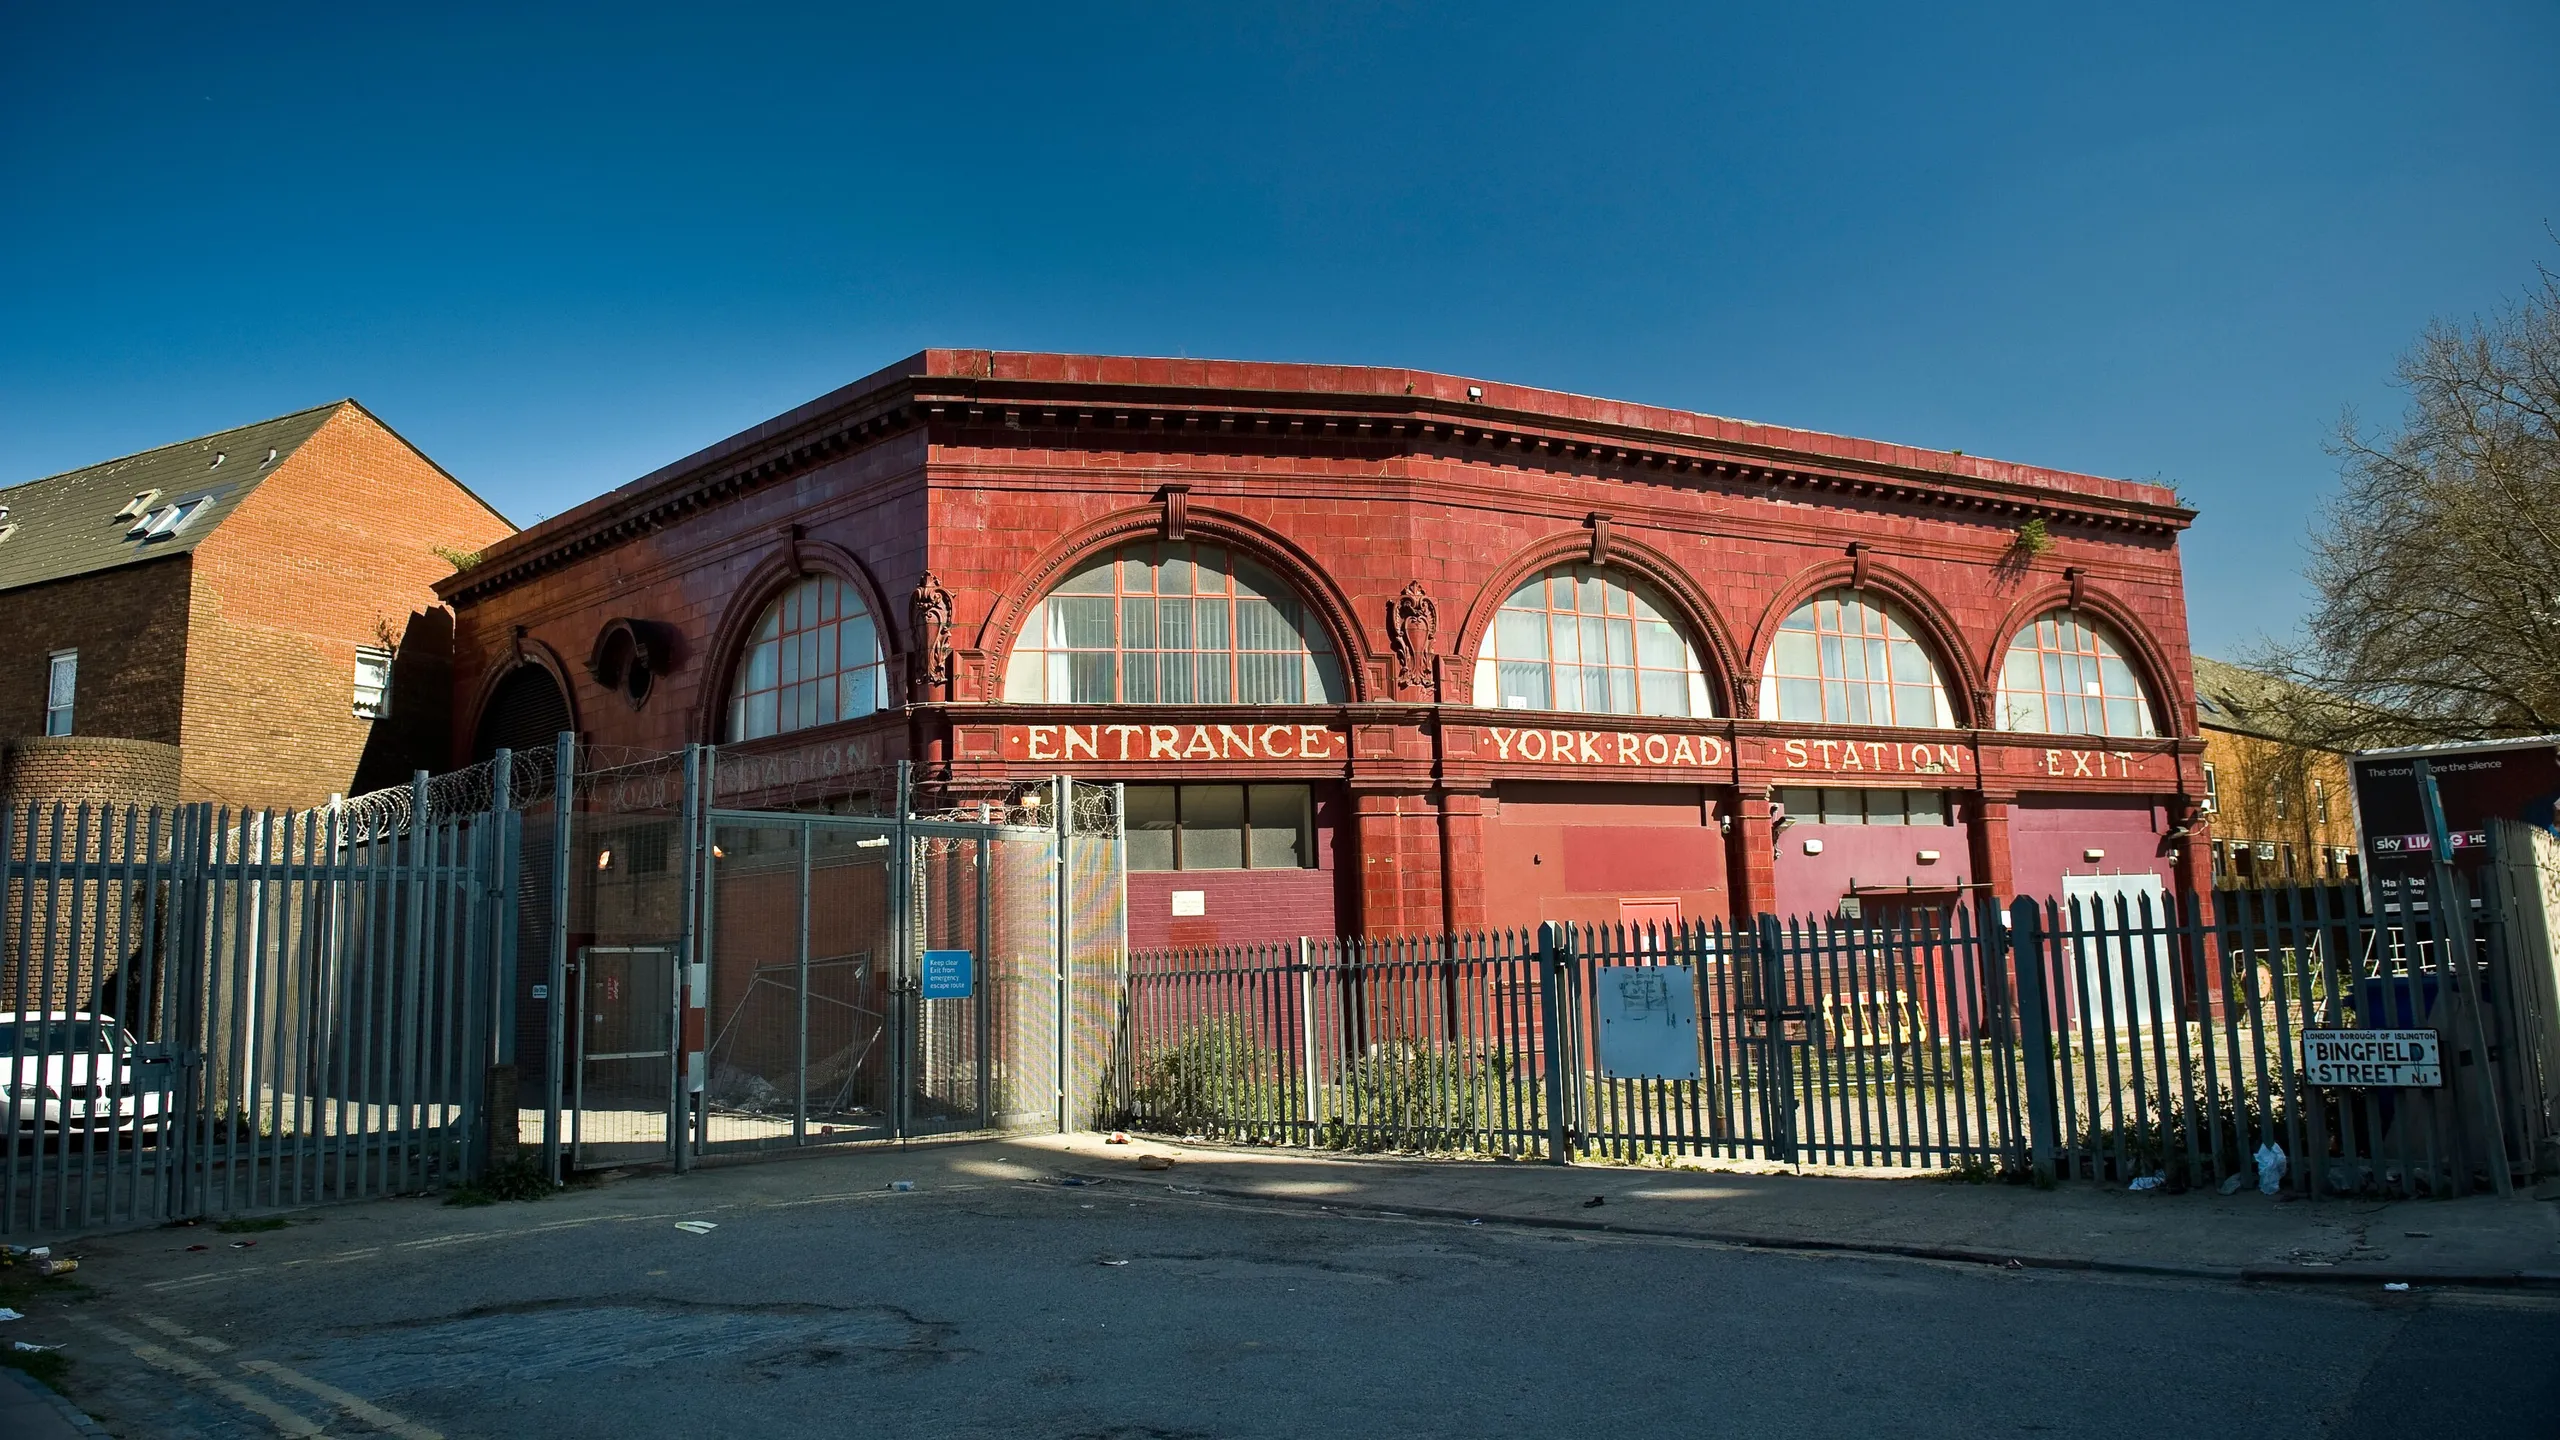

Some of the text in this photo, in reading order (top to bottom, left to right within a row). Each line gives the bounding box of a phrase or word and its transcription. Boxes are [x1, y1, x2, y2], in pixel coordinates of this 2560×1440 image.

[1027, 724, 1331, 761] ENTRANCE
[1489, 726, 1723, 766] YORK ROAD
[1785, 738, 1962, 773] STATION
[2045, 748, 2134, 778] EXIT
[2367, 768, 2386, 777] The
[2388, 767, 2414, 777] story
[2449, 763, 2467, 772] the
[2468, 760, 2502, 770] silence
[2376, 837, 2401, 851] sky
[2408, 834, 2464, 849] LIVG
[930, 959, 944, 967] Keep
[2305, 1032, 2436, 1040] LONDON BOROUGH OF ISLINGTON
[2316, 1042, 2425, 1062] BINGFIELD
[2318, 1064, 2401, 1083] STREET
